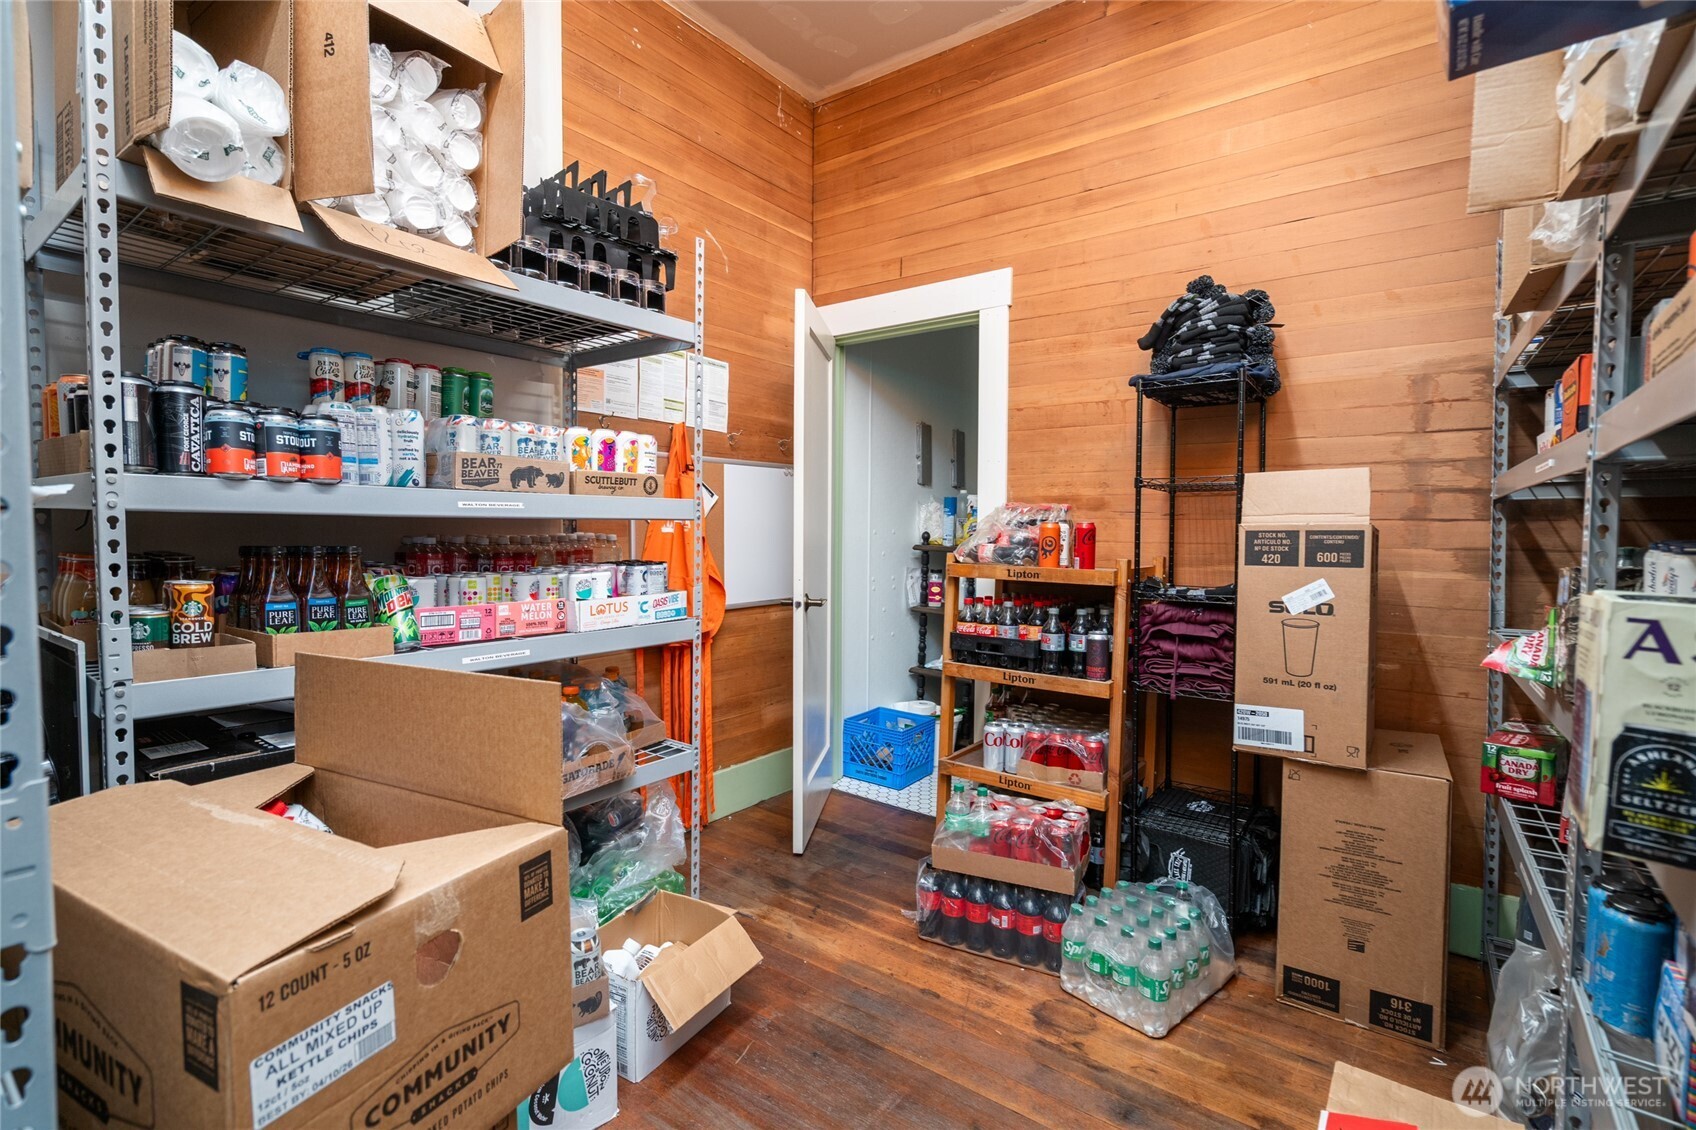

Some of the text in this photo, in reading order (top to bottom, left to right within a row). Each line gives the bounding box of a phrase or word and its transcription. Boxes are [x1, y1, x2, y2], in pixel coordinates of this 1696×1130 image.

[324, 32, 335, 58] 412
[315, 365, 341, 376] Cider
[190, 397, 201, 472] CAVATICA
[240, 431, 255, 443] STO
[276, 435, 300, 446] STOU
[300, 438, 317, 448] OUT
[462, 458, 496, 469] BEAR
[462, 469, 499, 478] BEAVER
[585, 476, 638, 486] SCUTTLEBUTT
[1262, 554, 1281, 564] 420
[1317, 552, 1338, 563] 600
[1006, 569, 1041, 579] Lipton
[653, 593, 680, 609] OASIS VIBE
[311, 606, 335, 614] PURE
[521, 603, 552, 612] WATER
[590, 602, 629, 617] LOTUS
[269, 610, 294, 619] PURE
[312, 611, 335, 619] LEAF
[348, 612, 368, 620] LEAF
[521, 611, 553, 621] MELON
[269, 617, 295, 625] LEAF
[172, 622, 213, 633] COLD
[172, 632, 213, 644] BREW
[1623, 617, 1696, 667] A
[1531, 631, 1544, 667] ANADA
[1003, 672, 1035, 685] Lipton
[1544, 671, 1553, 682] 12
[1323, 684, 1337, 692] oz)
[1500, 760, 1539, 770] CANADA
[1508, 768, 1529, 776] DRY
[999, 776, 1031, 791] Lipton
[1496, 783, 1538, 796] fruit splash
[524, 878, 549, 897] MAKE A
[576, 962, 600, 978] BEAR
[258, 991, 275, 1012] 12
[280, 963, 329, 1001] COUNT
[343, 952, 352, 969] 5
[355, 942, 372, 962] OZ
[576, 971, 601, 985] BEAVE
[1304, 976, 1331, 991] 1000
[1391, 998, 1413, 1013] 316
[1377, 1013, 1389, 1021] NO.
[1381, 1008, 1402, 1019] STOCK
[253, 1012, 342, 1069] COMMUNITY
[345, 983, 394, 1015] SNACKS
[1394, 1025, 1417, 1036] STOCK
[265, 1000, 383, 1080] ALL MIXED UP
[276, 1019, 379, 1089] KETTLE CHIPS
[395, 1054, 429, 1085] CHIPPING
[430, 1043, 439, 1054] IN
[448, 1026, 471, 1040] GIVING
[365, 1013, 511, 1128] COMMUNITY
[257, 1059, 354, 1127] BEST BY: 04/10/26
[257, 1092, 282, 1113] 12ct
[291, 1075, 310, 1092] 5oz
[420, 1076, 471, 1116] SNACKS
[452, 1068, 509, 1121] POTATO CHIPS
